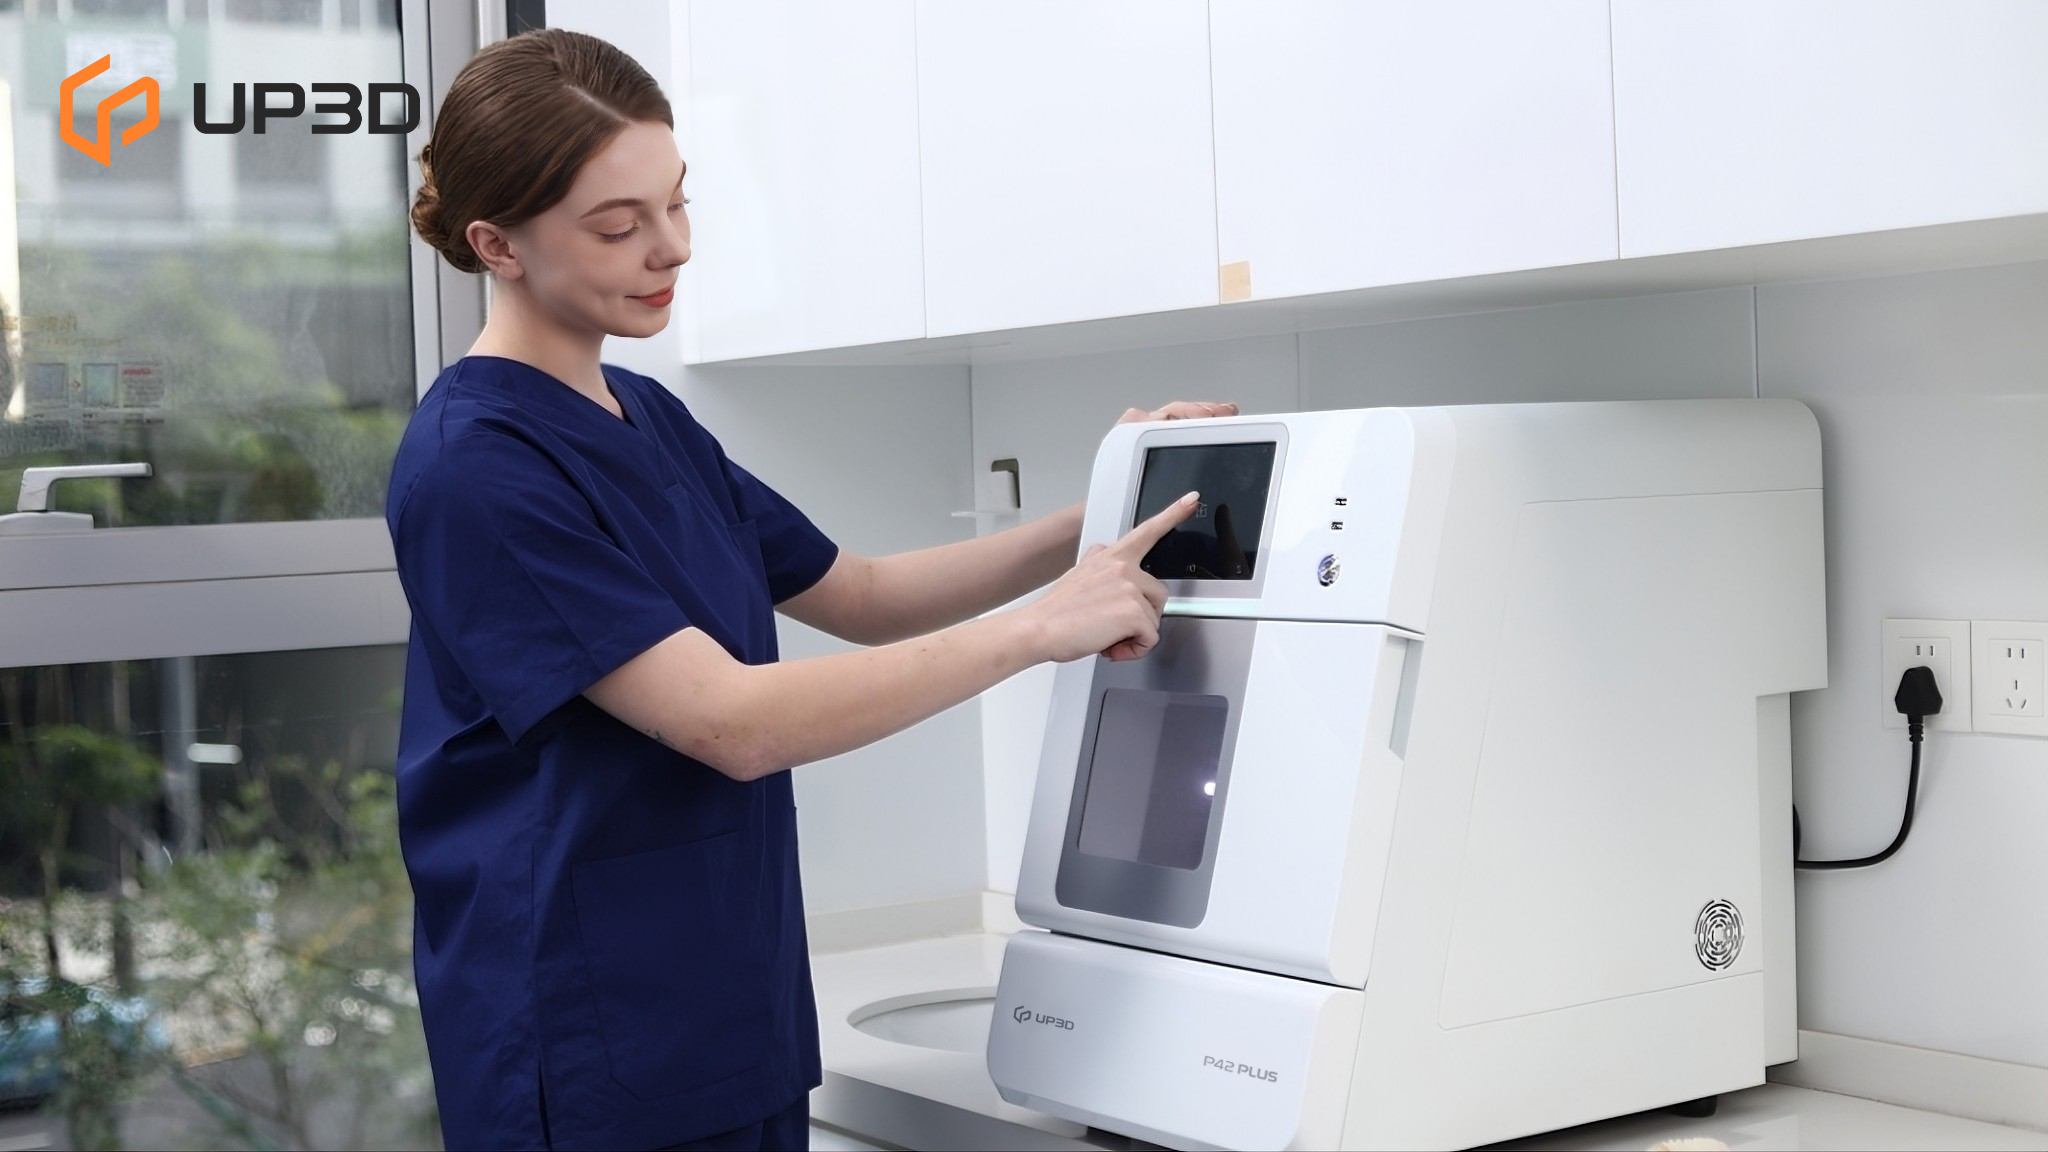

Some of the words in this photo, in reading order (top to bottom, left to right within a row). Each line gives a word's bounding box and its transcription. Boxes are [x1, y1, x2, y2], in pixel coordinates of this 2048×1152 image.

[1035, 1013, 1075, 1031] UP3D
[1203, 1055, 1235, 1073] P42
[1237, 1063, 1278, 1083] PLUS
